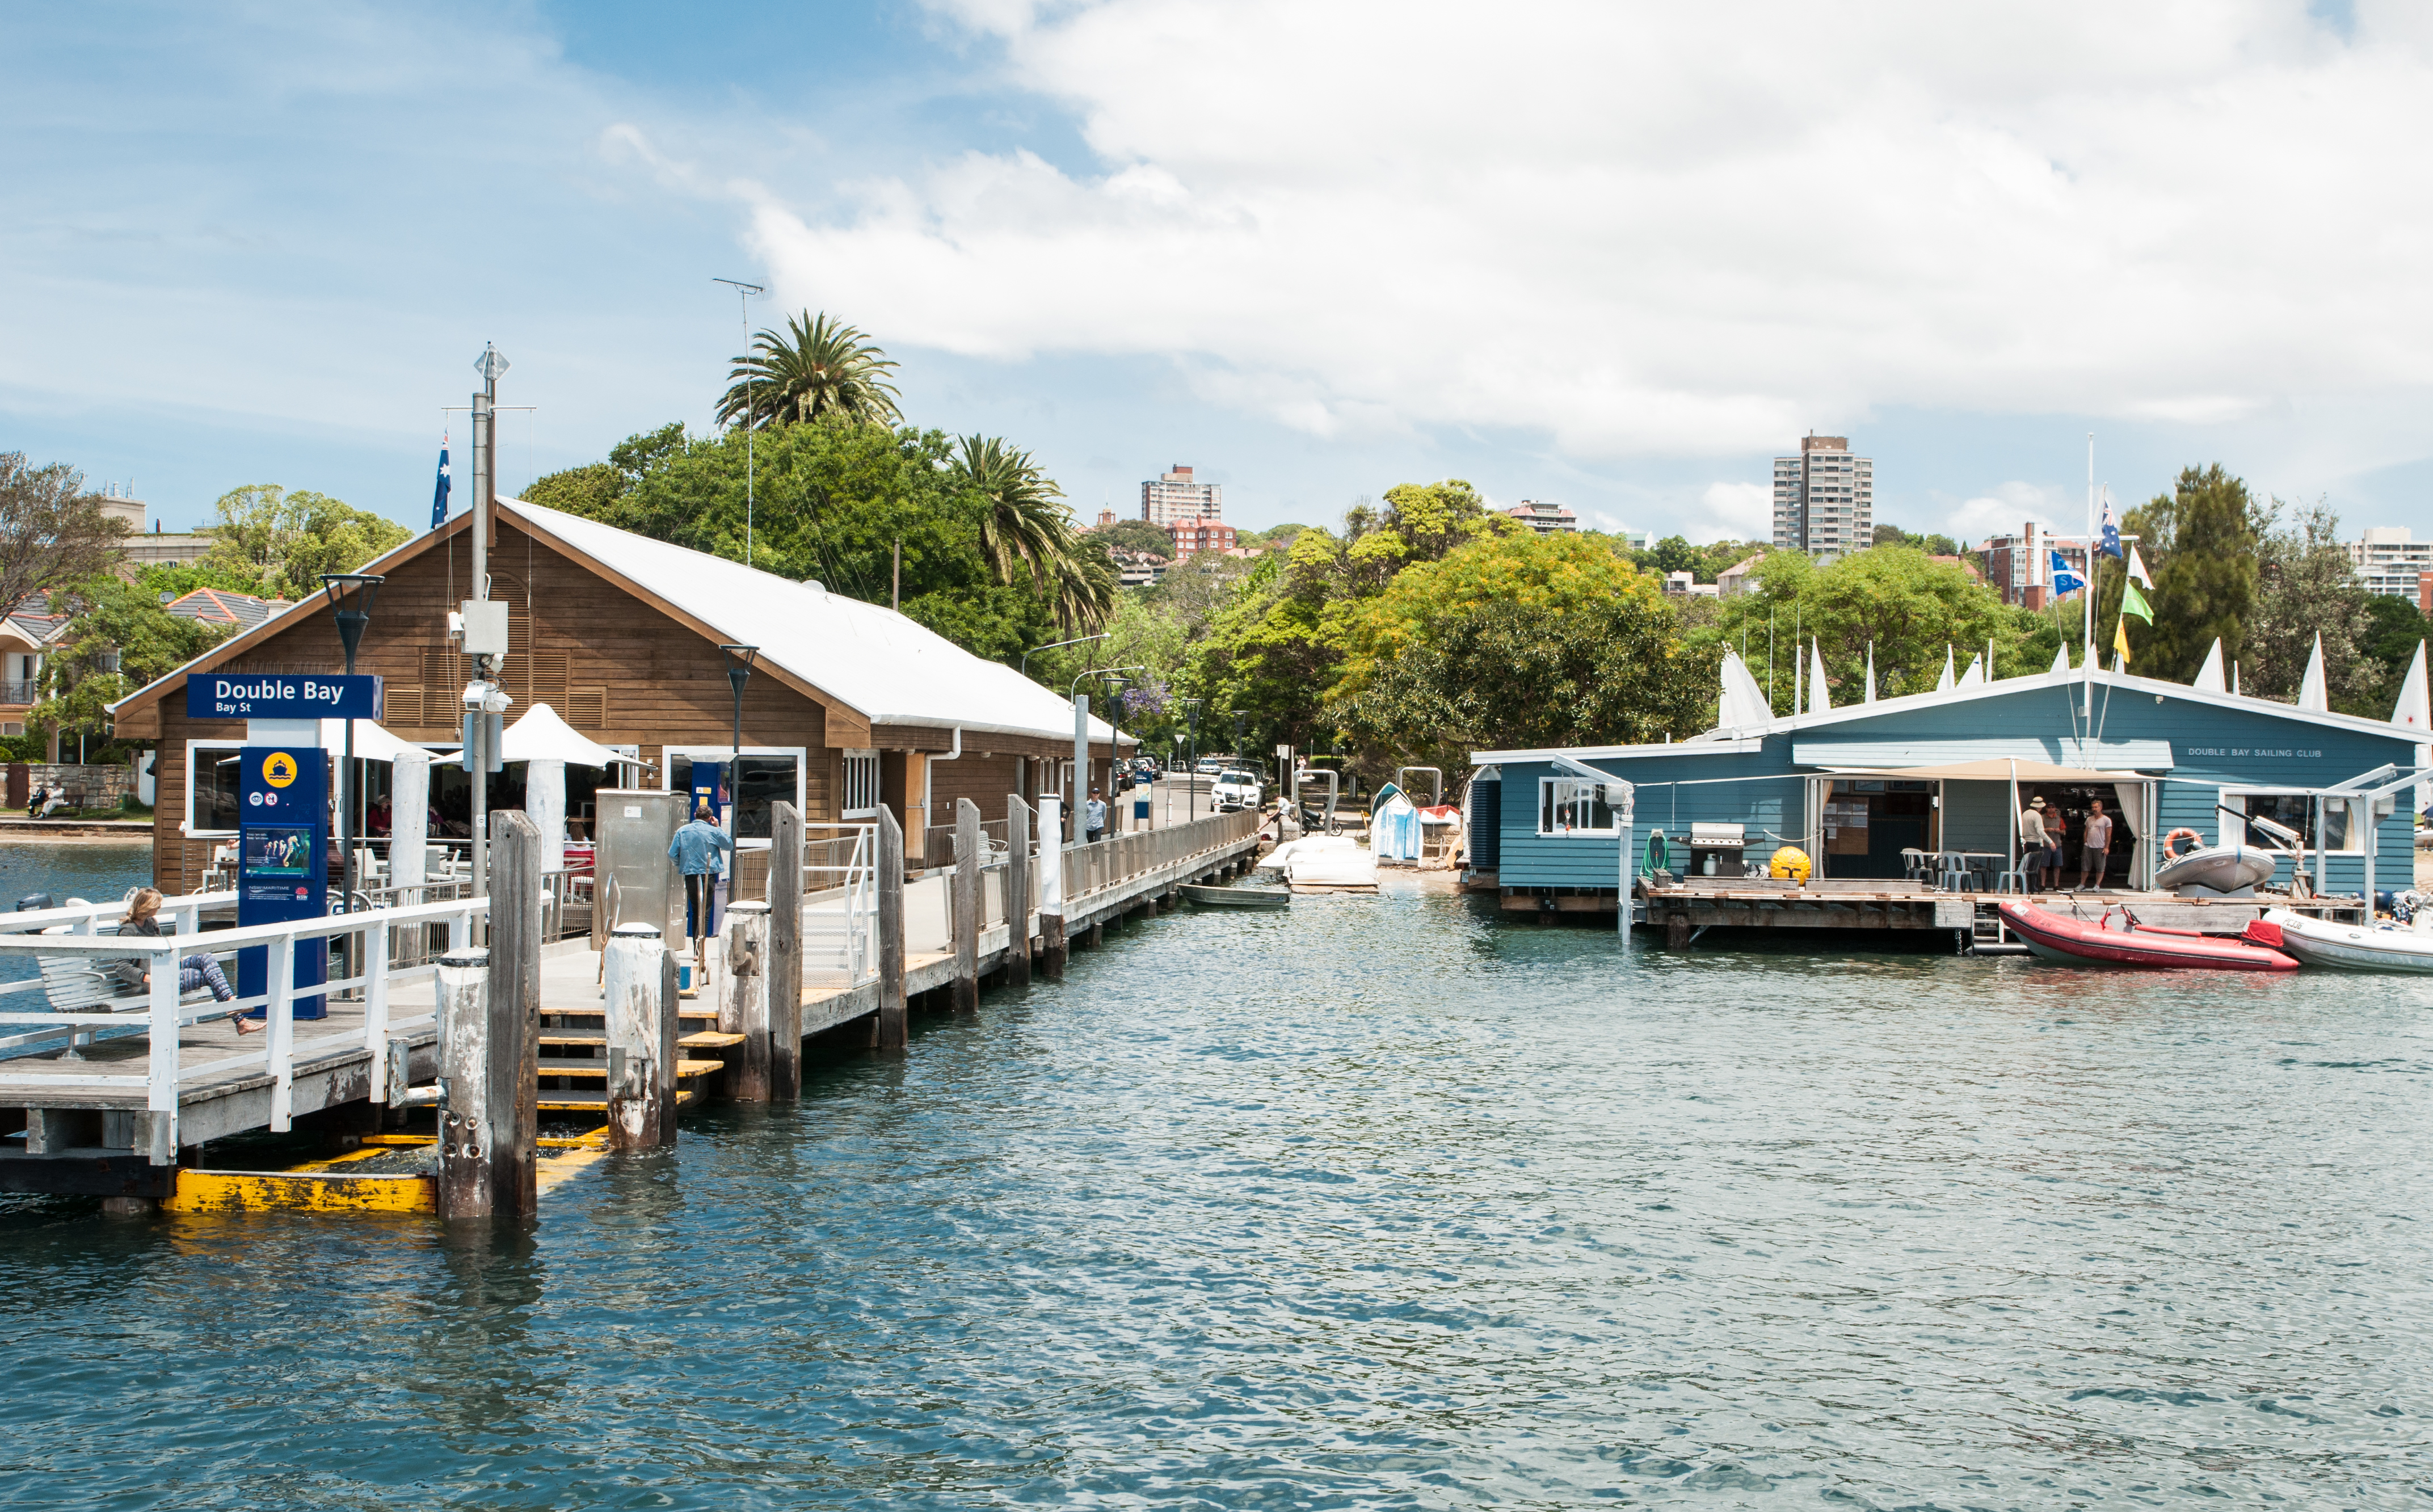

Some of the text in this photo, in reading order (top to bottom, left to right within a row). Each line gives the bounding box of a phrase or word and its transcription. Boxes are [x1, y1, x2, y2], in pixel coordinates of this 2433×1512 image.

[216, 680, 344, 705] Double Bay
[216, 702, 251, 714] Bay St
